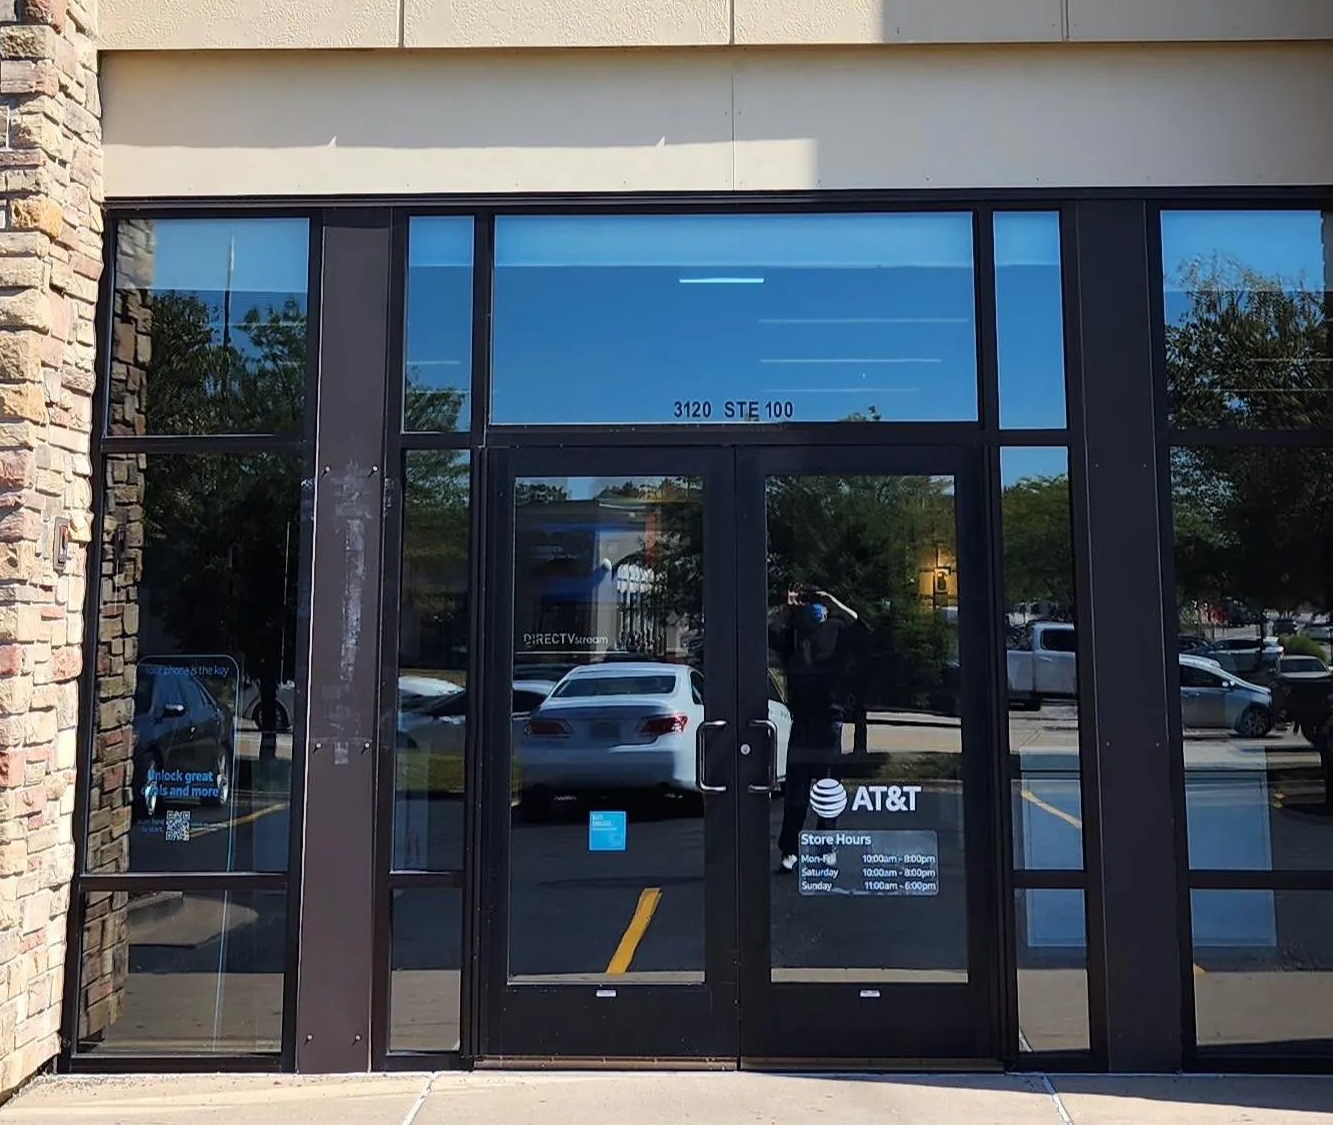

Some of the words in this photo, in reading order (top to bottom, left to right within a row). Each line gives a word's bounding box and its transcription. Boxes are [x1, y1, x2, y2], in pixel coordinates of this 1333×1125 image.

[673, 401, 712, 418] 3120
[724, 401, 759, 418] STE
[765, 401, 793, 418] 100
[199, 665, 213, 675] the
[214, 665, 230, 677] key
[147, 769, 183, 781] Unlock
[184, 771, 214, 784] great
[141, 785, 168, 796] als
[170, 784, 190, 796] and
[192, 787, 219, 797] more
[851, 785, 922, 812] AT&T
[801, 834, 834, 845] Store
[836, 834, 872, 845] Hours
[862, 855, 897, 863] 10:00am
[801, 868, 839, 879] Saturday
[863, 869, 898, 877] 10:00am
[801, 881, 832, 892] Sunday
[864, 882, 898, 890] 11:00am
[904, 881, 937, 891] 6:00pm
